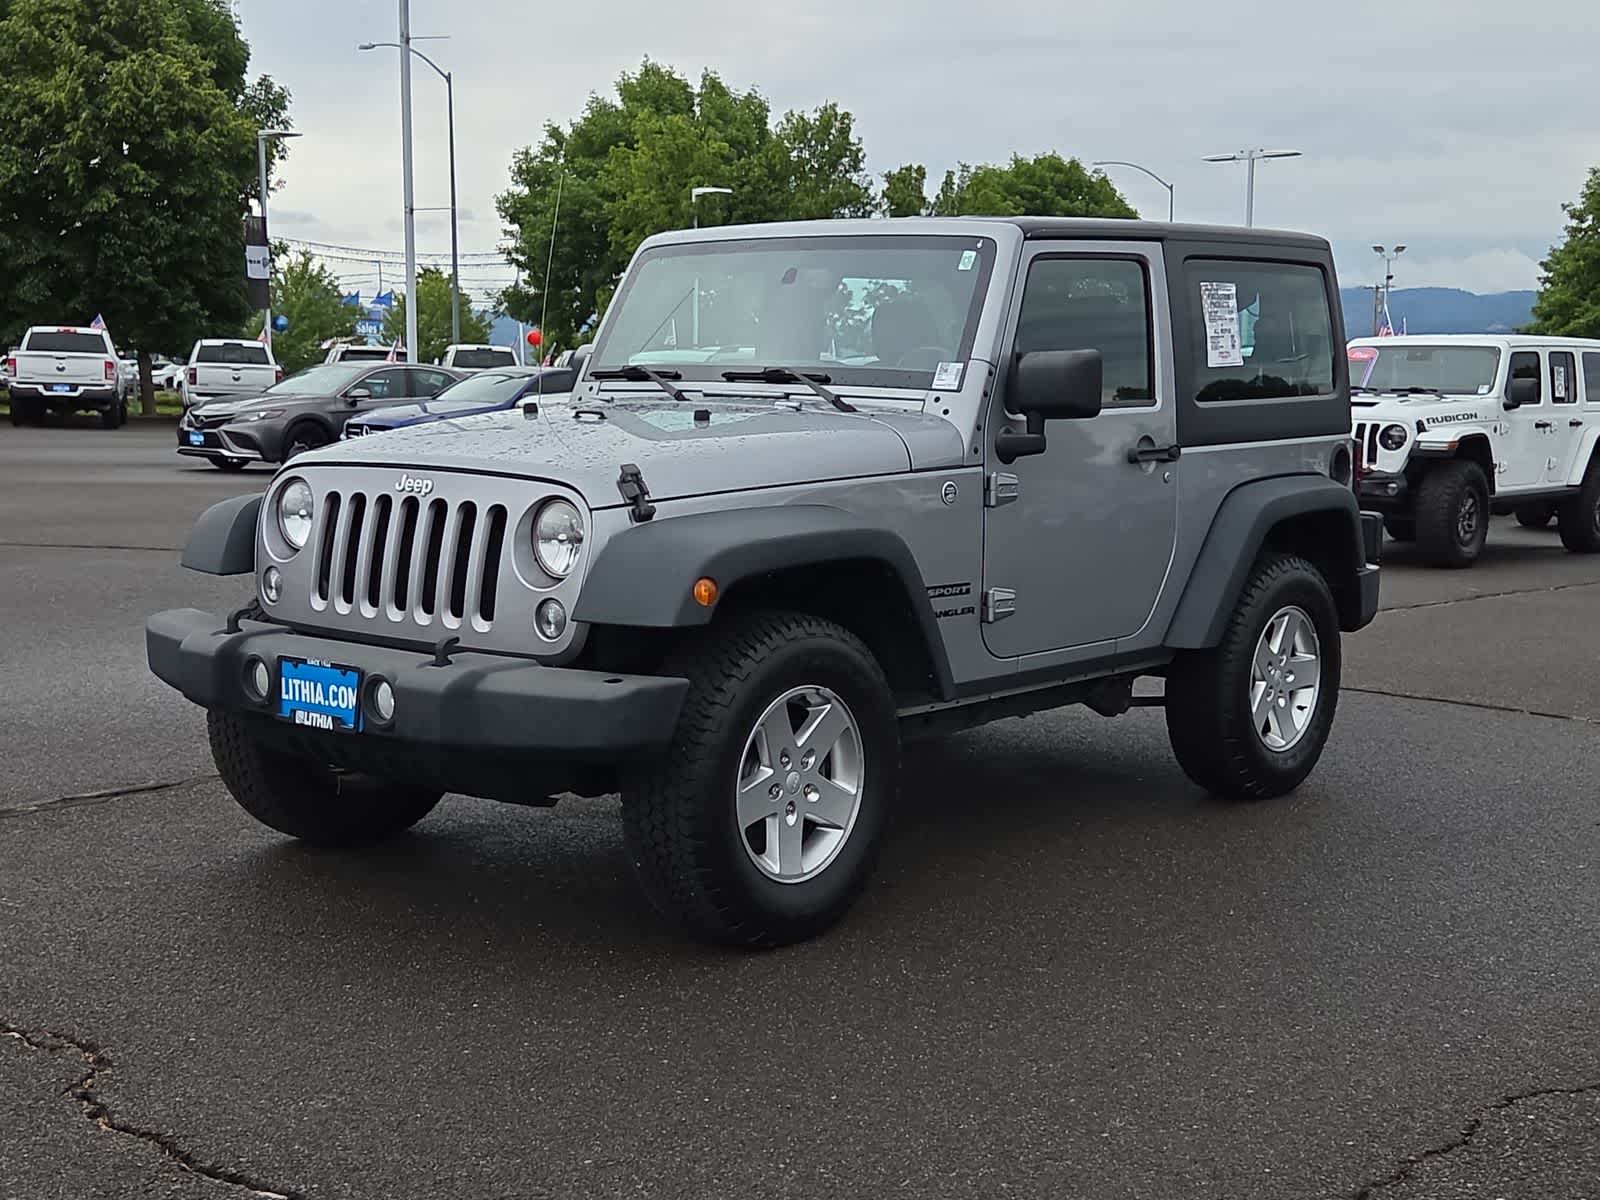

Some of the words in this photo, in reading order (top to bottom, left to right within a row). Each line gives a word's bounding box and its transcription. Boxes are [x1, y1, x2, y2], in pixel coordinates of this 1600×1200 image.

[1425, 411, 1478, 425] RUBICON
[395, 473, 434, 497] Jeep
[927, 585, 968, 598] SPORT
[304, 712, 334, 731] LITHIA
